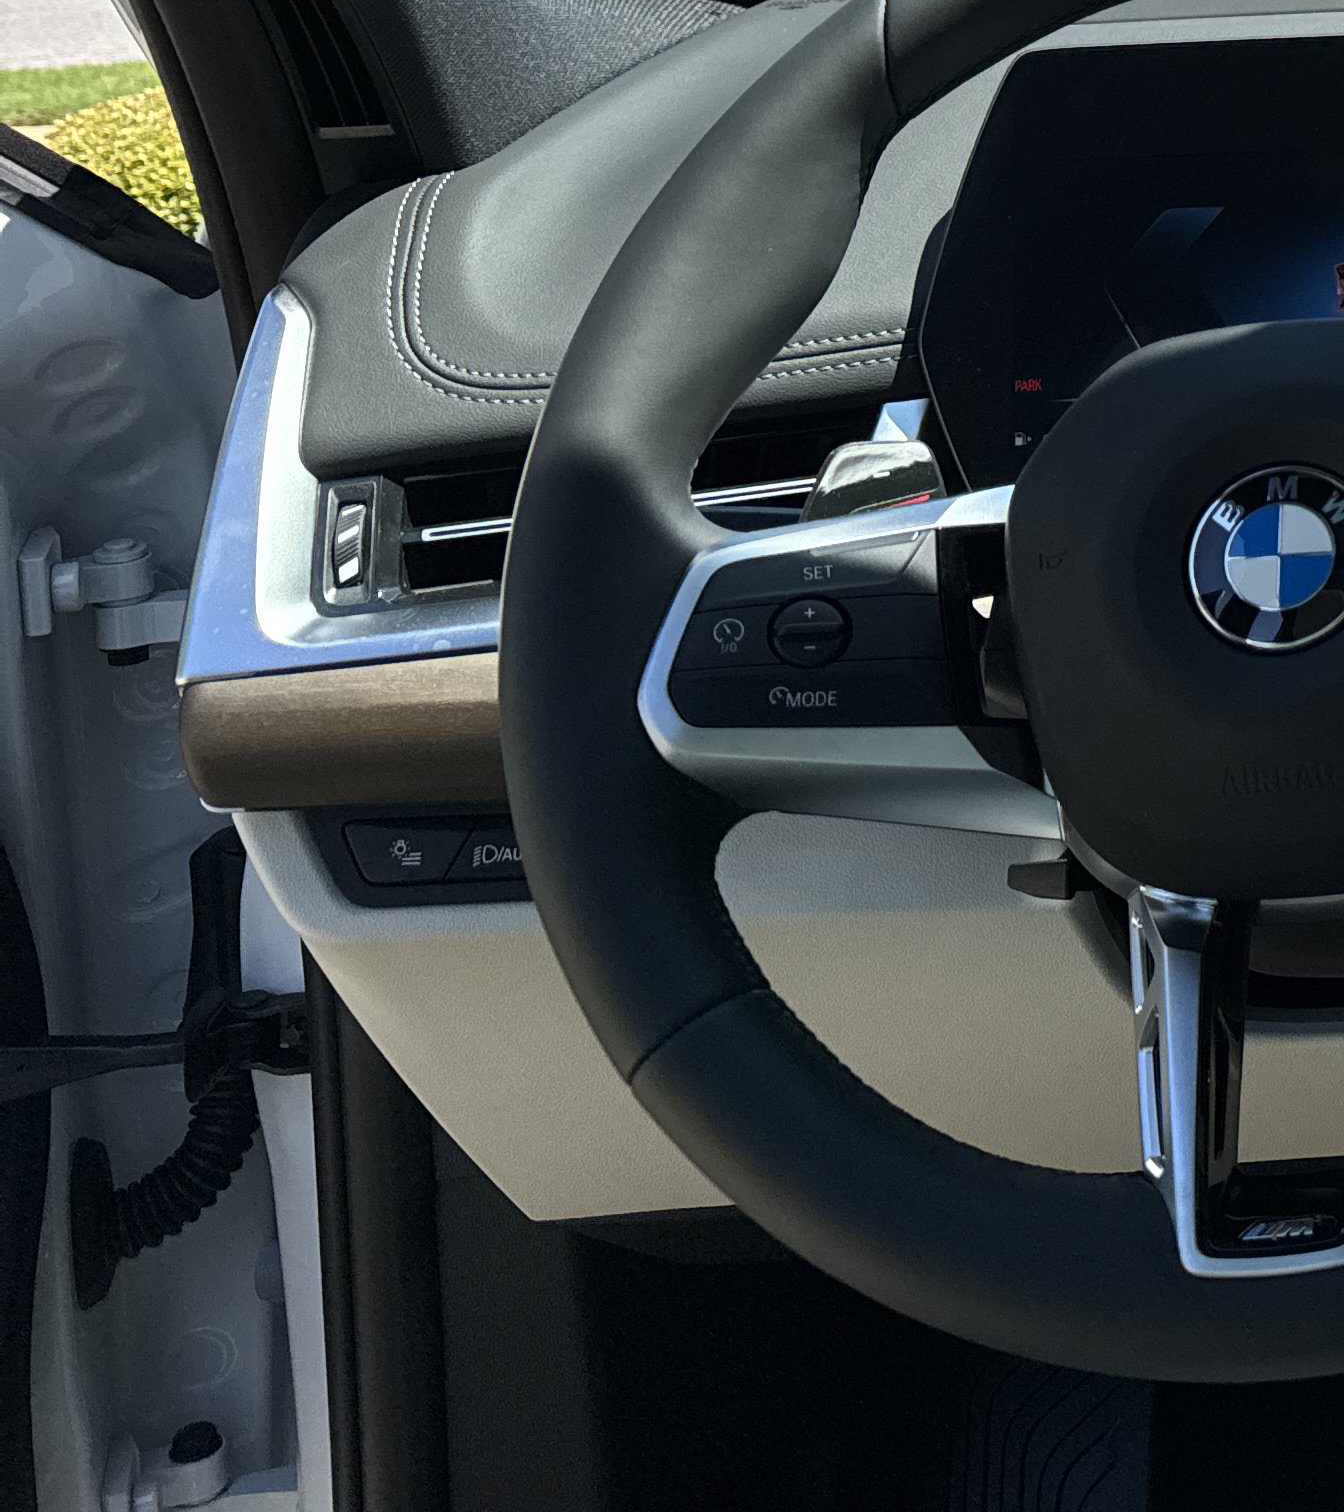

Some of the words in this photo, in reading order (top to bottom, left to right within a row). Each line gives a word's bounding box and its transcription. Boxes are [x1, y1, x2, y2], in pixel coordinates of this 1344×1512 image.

[1014, 378, 1044, 393] PARK
[803, 565, 835, 581] SET
[785, 690, 837, 708] MODE
